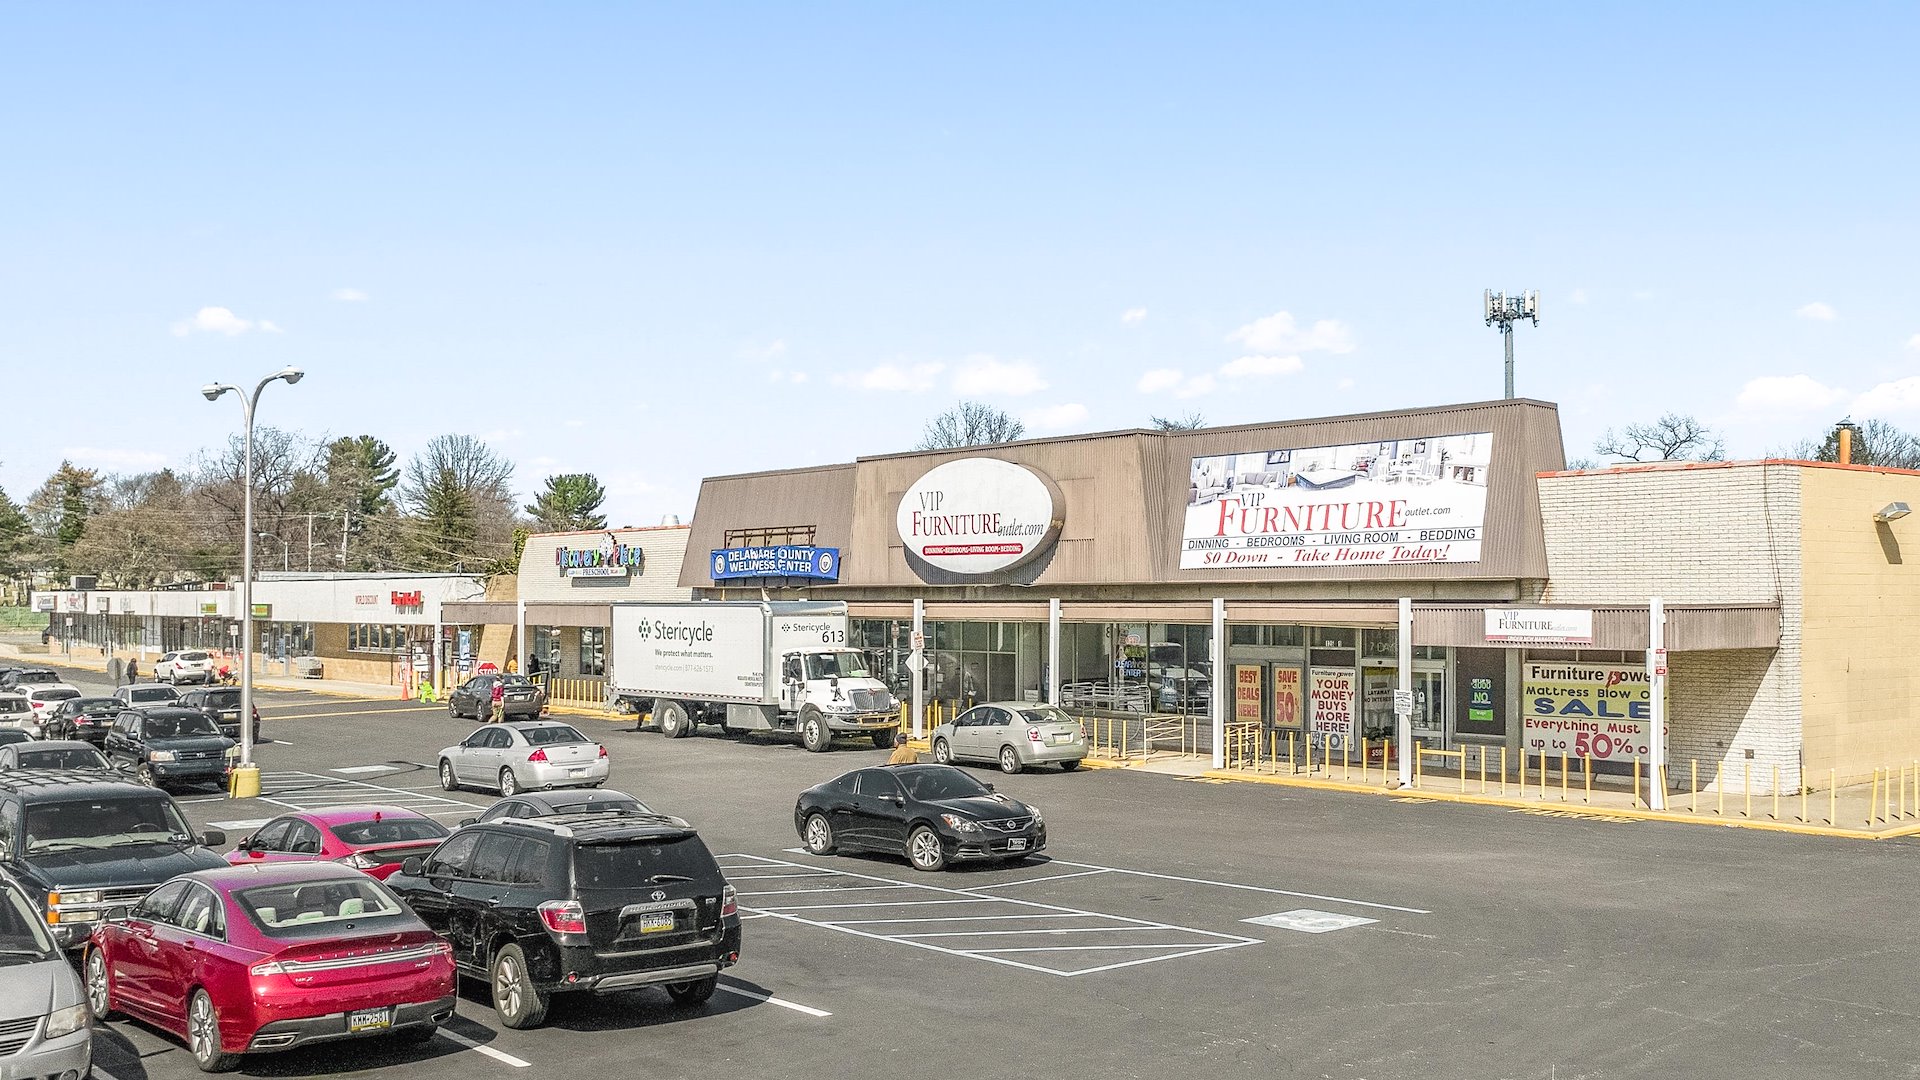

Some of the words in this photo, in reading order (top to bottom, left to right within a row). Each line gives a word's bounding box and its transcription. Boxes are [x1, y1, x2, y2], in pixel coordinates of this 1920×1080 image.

[919, 491, 944, 511] VIP
[1241, 493, 1265, 507] VIP
[912, 511, 1001, 536] FURNITURE
[998, 518, 1044, 537] outlet.com
[1214, 499, 1407, 537] FURNITURE
[1405, 507, 1451, 517] outlet.com
[1188, 539, 1229, 549] DINNING
[1247, 536, 1305, 547] BEDROOMS
[1324, 533, 1361, 545] LIVING
[1364, 532, 1399, 543] ROOM
[1420, 528, 1476, 541] BEDDING
[556, 547, 600, 568] Discovery
[613, 544, 641, 566] Place
[728, 549, 776, 562] DELAWARE
[1203, 551, 1222, 564] $0
[1225, 551, 1268, 564] Down
[1294, 548, 1330, 562] Take
[1335, 547, 1385, 561] Home
[1391, 544, 1450, 562] Today!
[729, 560, 775, 573] WELLNESS
[1503, 611, 1519, 620] VIP
[793, 622, 831, 633] Stericycle
[1499, 619, 1553, 630] FURNITURE
[654, 620, 713, 647] Stericycle
[822, 630, 844, 643] 613
[663, 649, 680, 658] protect
[680, 650, 693, 658] what
[1240, 671, 1257, 683] BEST
[1278, 670, 1297, 683] SAVE
[1532, 666, 1604, 680] Furniture
[1605, 671, 1650, 688] powe
[1317, 679, 1349, 690] YOUR
[1237, 687, 1260, 700] DEALS
[1312, 690, 1354, 701] MONEY
[1474, 692, 1489, 702] NO
[1526, 686, 1589, 697] Mattress
[1598, 688, 1631, 699] Blow
[1238, 704, 1258, 717] HERE!
[1318, 701, 1347, 711] BUYS
[1534, 697, 1650, 719] SALE
[1315, 711, 1350, 722] MORE
[1316, 722, 1349, 733] HERE!
[1525, 719, 1599, 735] Everything
[1607, 723, 1641, 734] Must
[1531, 739, 1545, 750] up
[1552, 739, 1567, 749] to
[1575, 732, 1634, 759] 50%
